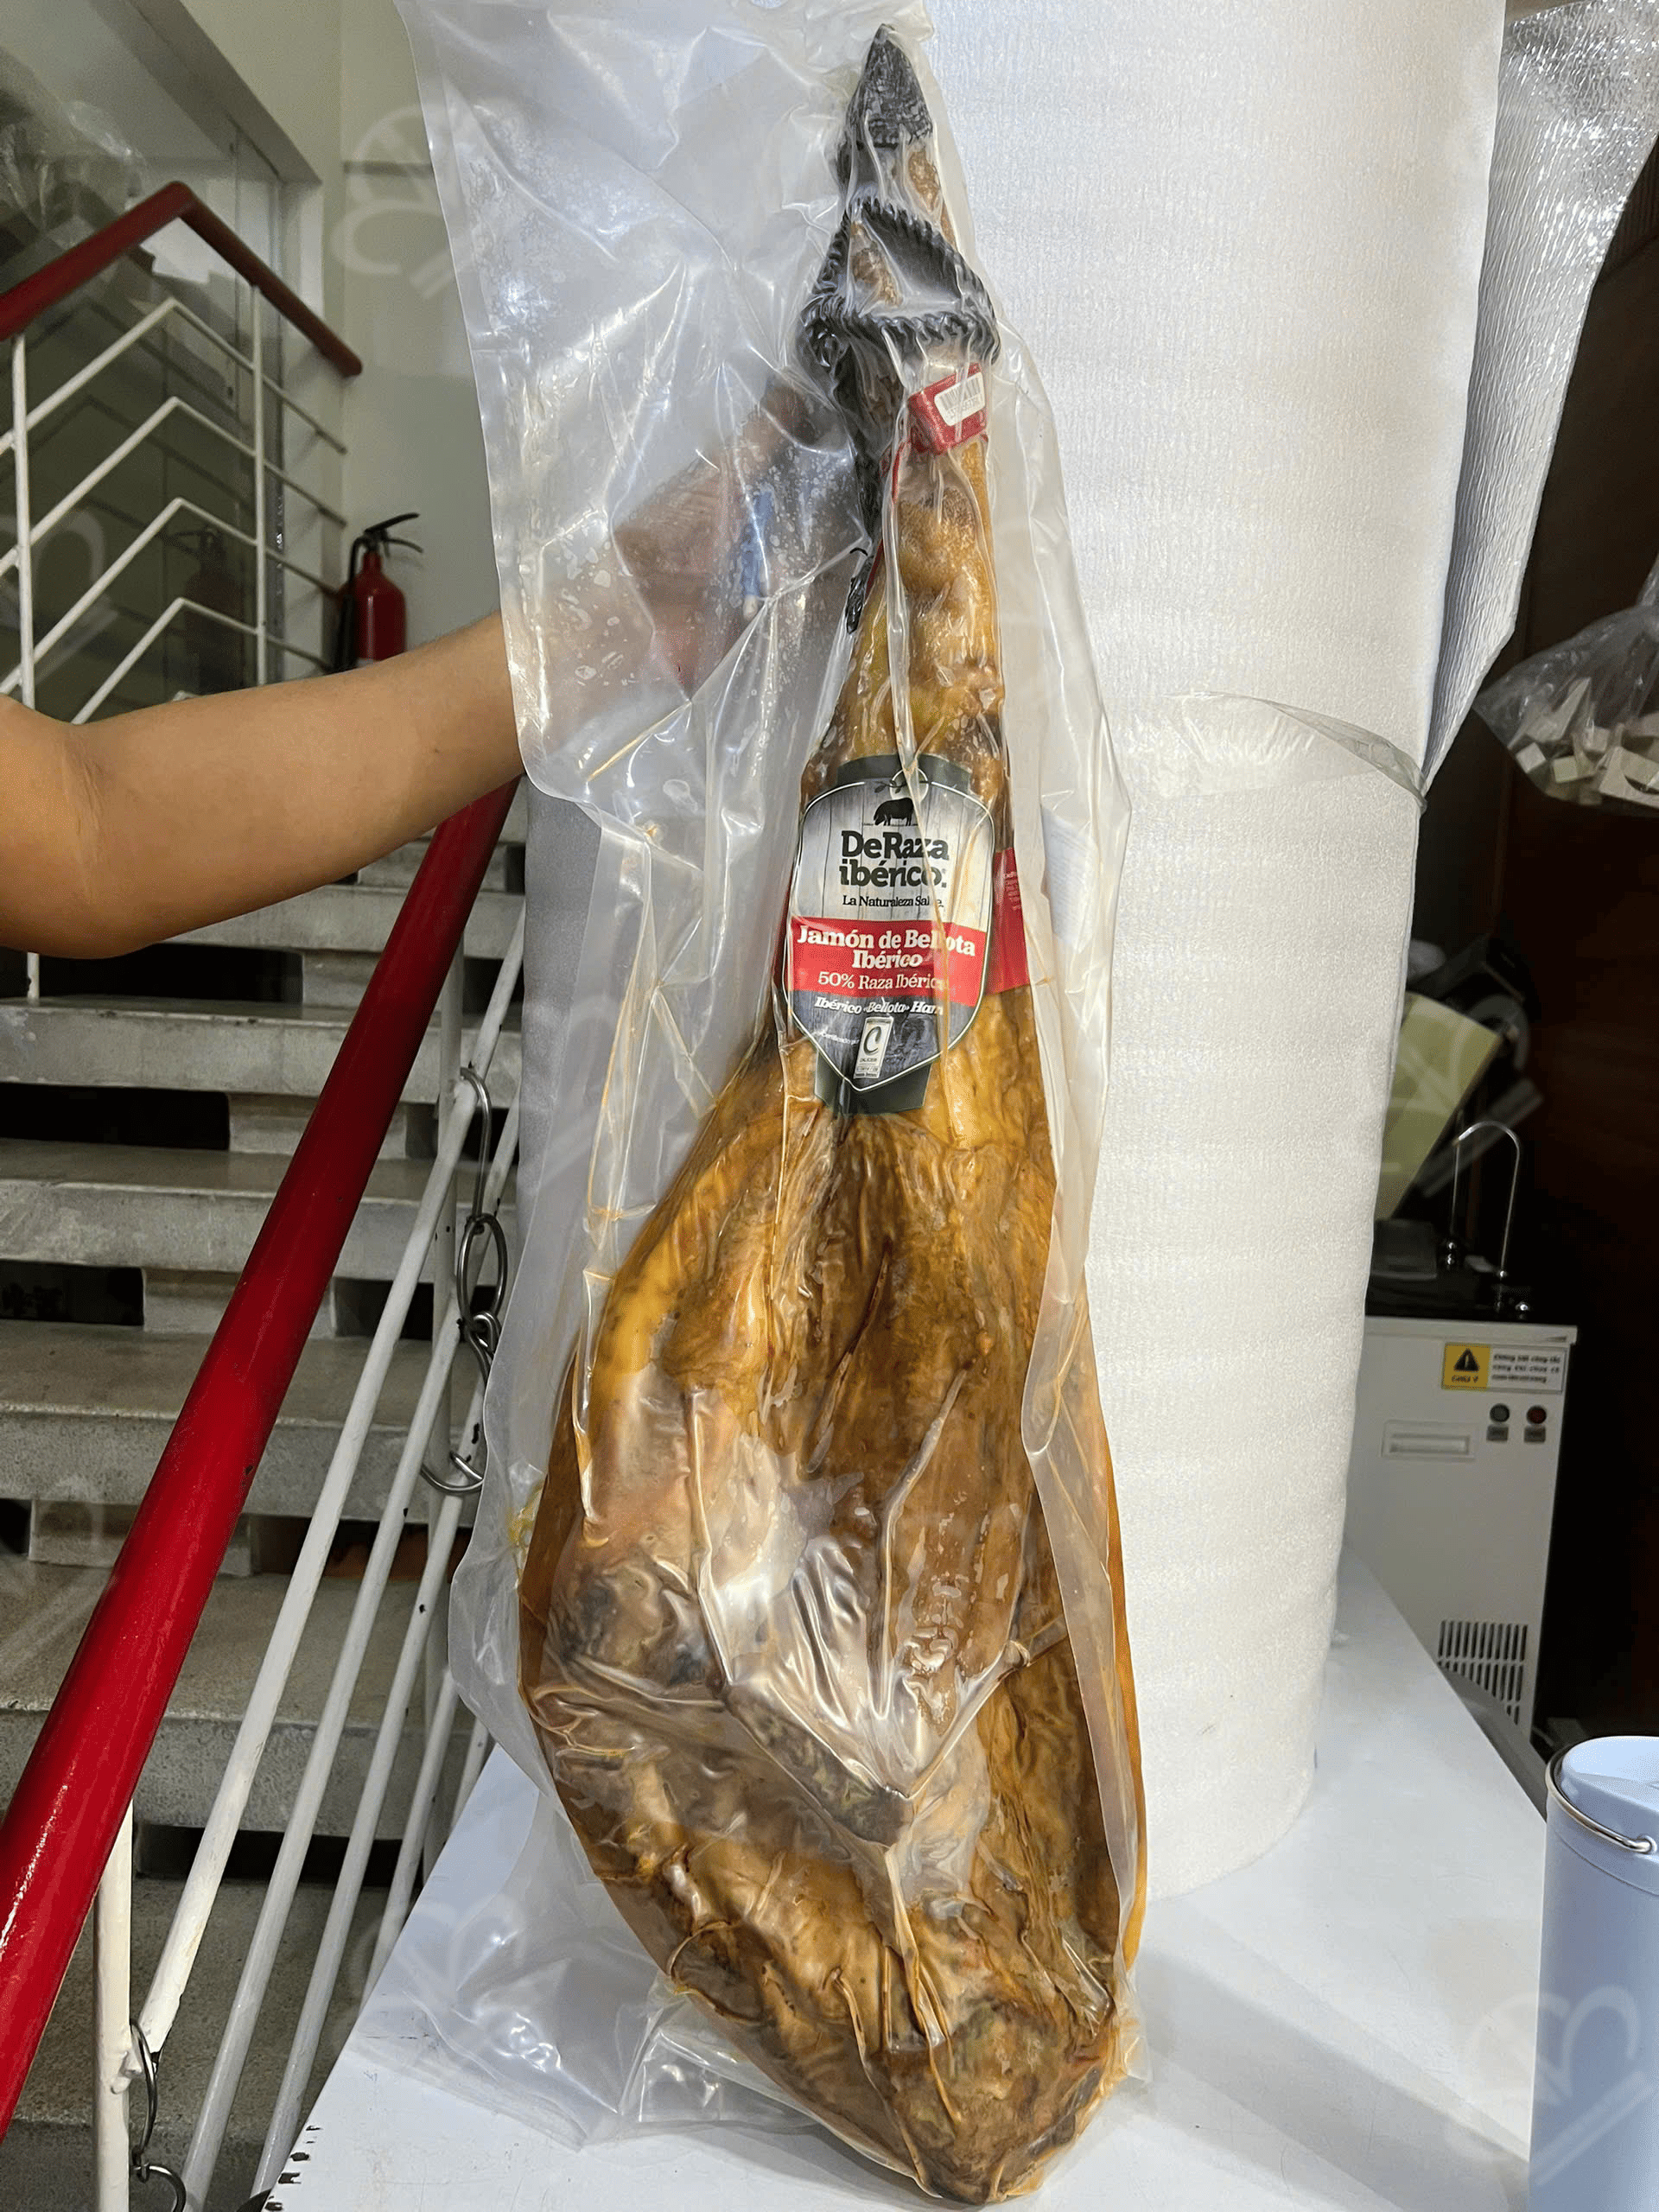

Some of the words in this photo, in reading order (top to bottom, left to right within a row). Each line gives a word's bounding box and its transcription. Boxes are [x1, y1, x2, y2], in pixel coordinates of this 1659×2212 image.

[842, 895, 856, 906] La
[859, 896, 913, 906] Naturaleza
[798, 925, 874, 949] Jamón
[879, 931, 901, 949] de
[852, 950, 923, 969] Ibérico
[817, 971, 855, 989] 50%
[858, 976, 893, 990] Raza
[814, 996, 861, 1014] Ibérico
